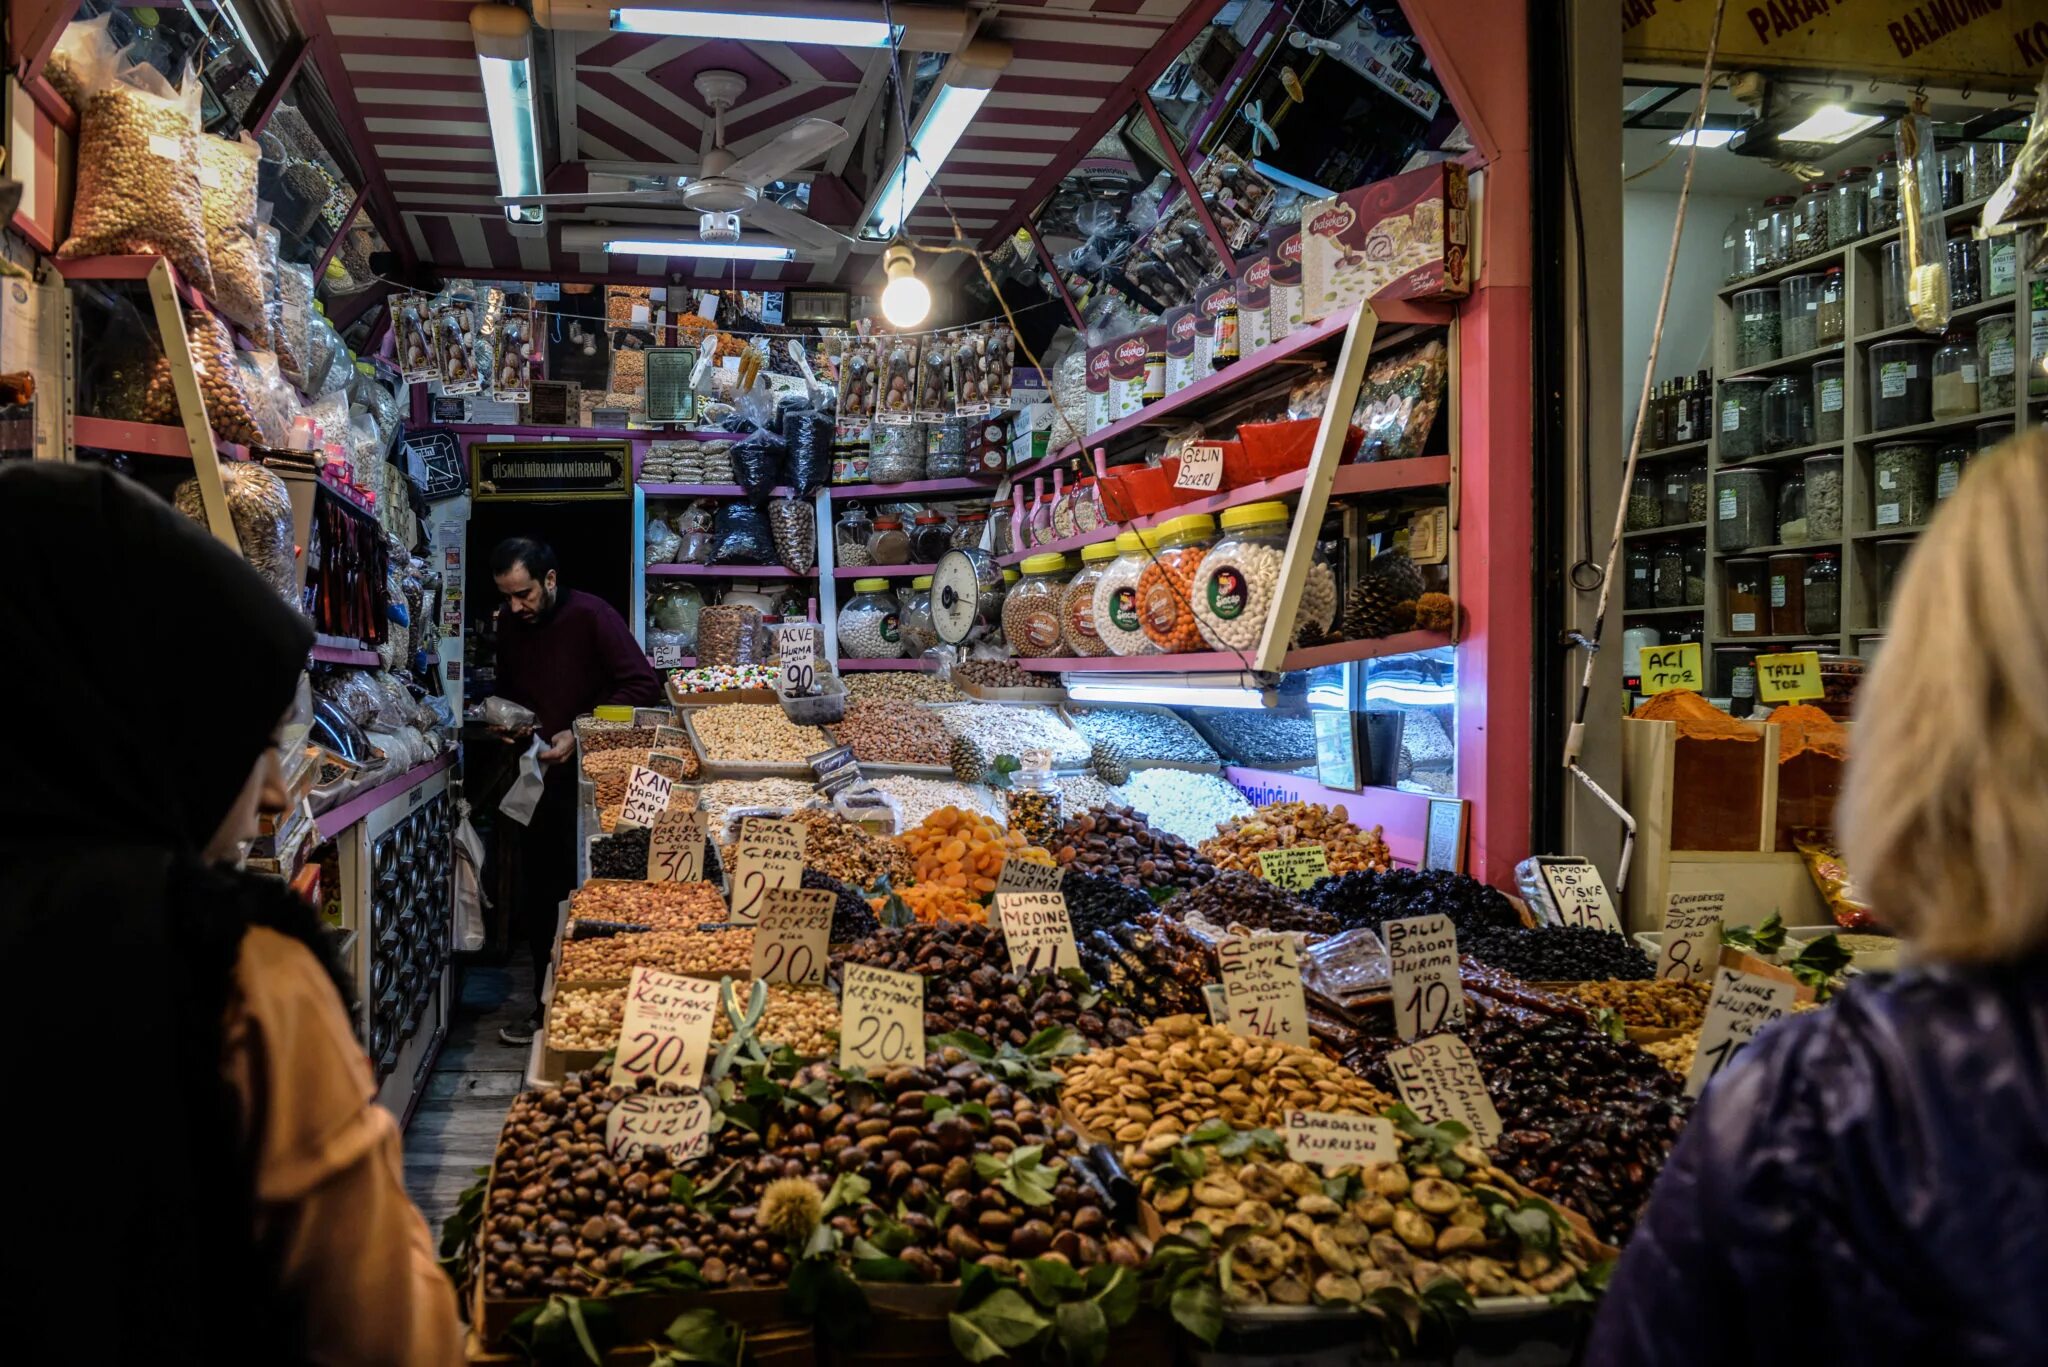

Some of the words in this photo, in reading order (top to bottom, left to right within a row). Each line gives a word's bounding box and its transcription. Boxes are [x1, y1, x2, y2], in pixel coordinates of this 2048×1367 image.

[1649, 650, 1684, 670] ACI
[1764, 664, 1805, 677] TATLI
[1770, 680, 1801, 690] TOZ
[635, 768, 672, 796] KAN
